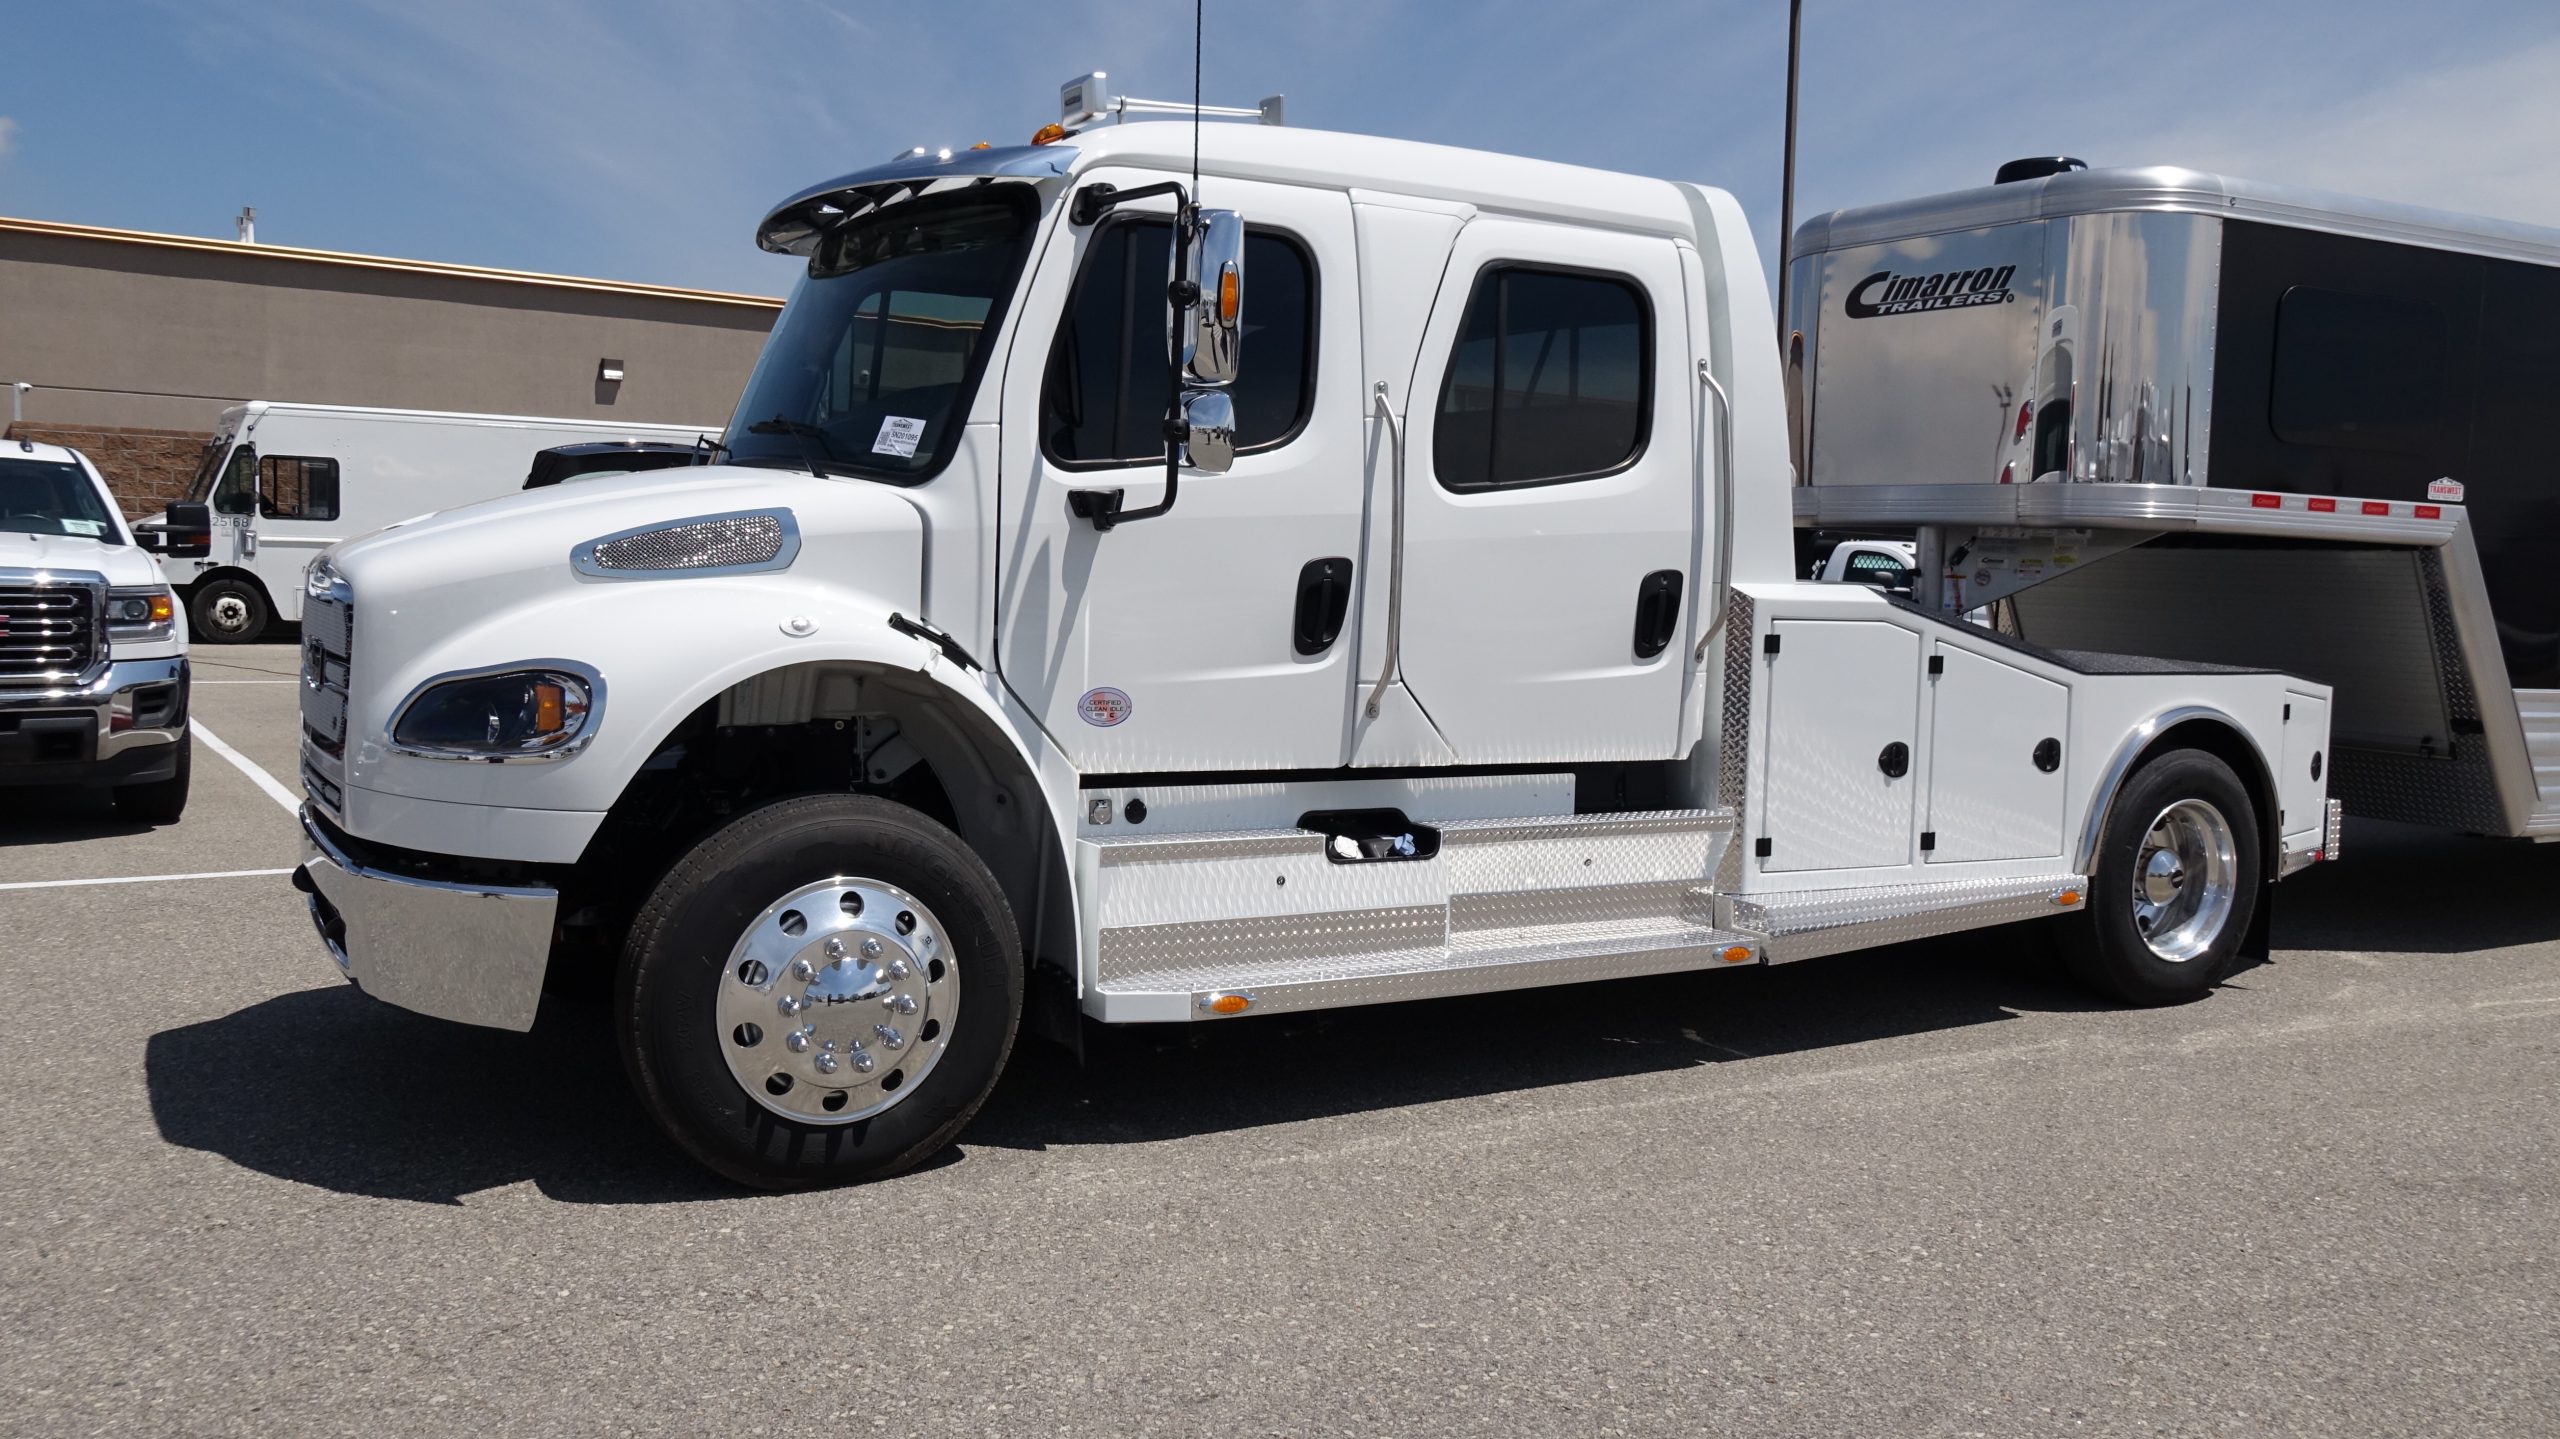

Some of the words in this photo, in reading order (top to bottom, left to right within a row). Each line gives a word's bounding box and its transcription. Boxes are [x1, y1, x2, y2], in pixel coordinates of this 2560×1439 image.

[1845, 264, 2016, 319] Cimarron
[1876, 290, 2003, 315] TRAILERS
[2430, 485, 2461, 495] TRANSWEST
[212, 516, 249, 528] 25168
